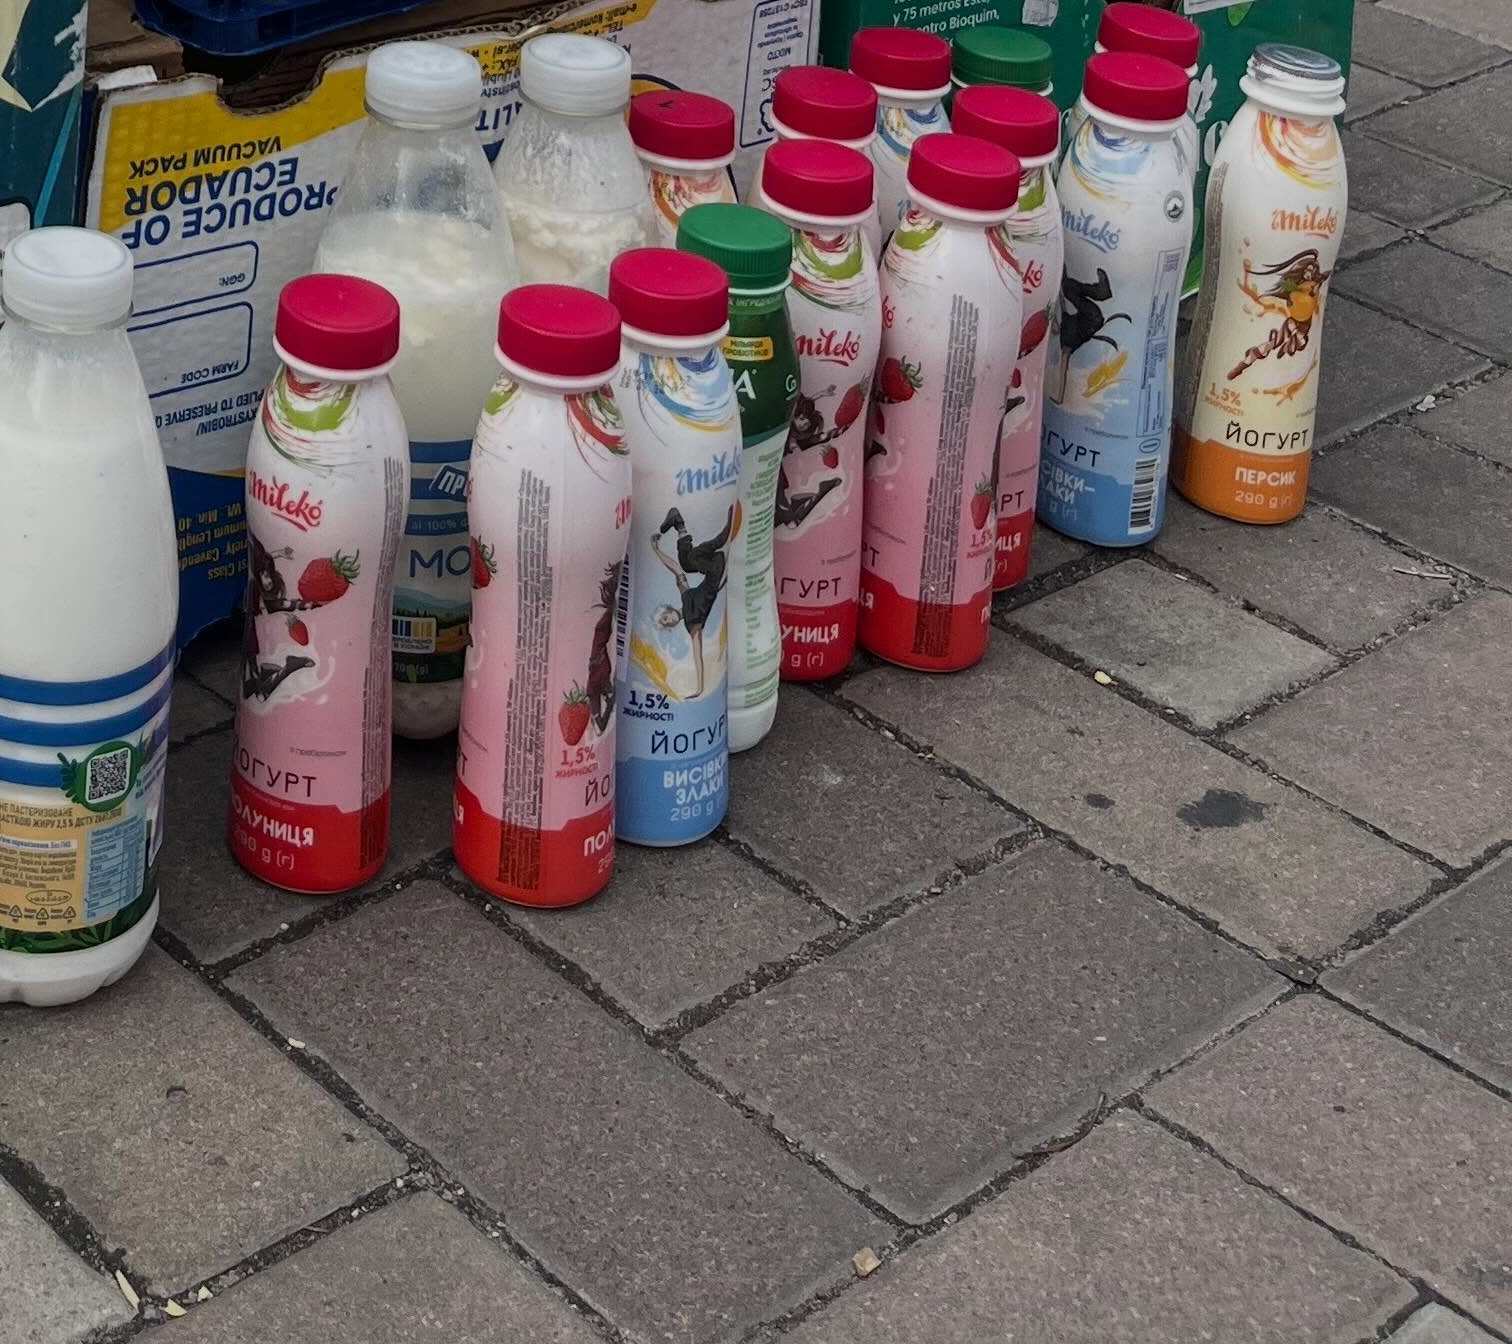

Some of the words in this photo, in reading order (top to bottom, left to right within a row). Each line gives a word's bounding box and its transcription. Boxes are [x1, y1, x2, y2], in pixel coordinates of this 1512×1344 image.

[903, 5, 918, 20] 75
[949, 8, 1000, 31] Bioquim,
[193, 136, 282, 168] VACUUM
[128, 151, 188, 180] PACK
[124, 157, 299, 217] ECUADOR
[121, 215, 171, 249] OF
[181, 367, 210, 385] CODE
[212, 359, 240, 377] FARM
[220, 398, 236, 412] TO
[1208, 382, 1242, 408] 1,5%
[165, 401, 219, 426] PRESERVE
[1225, 419, 1310, 451] ЙОГУРТ
[1234, 466, 1297, 488] ПЕРСИК
[1235, 489, 1264, 507] 290
[628, 689, 670, 710] 1,5%
[622, 706, 674, 722] ЖИРНОСТІ
[562, 743, 595, 766] 1,5%
[669, 803, 702, 822] 290
